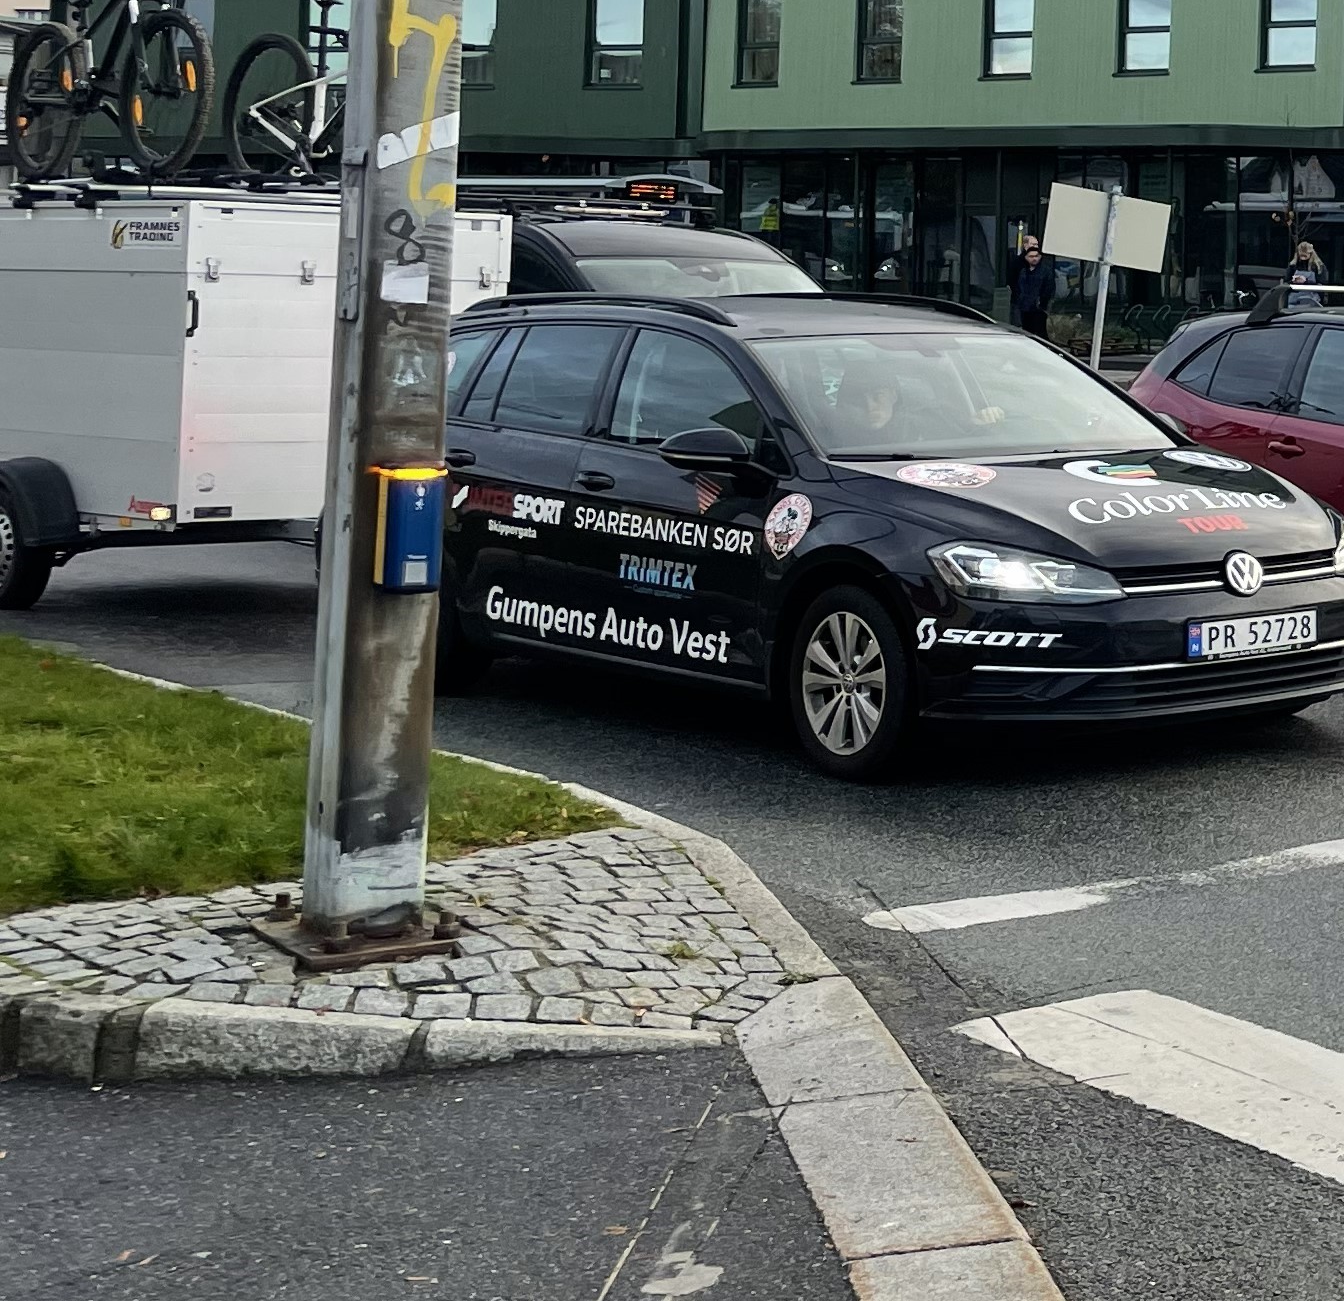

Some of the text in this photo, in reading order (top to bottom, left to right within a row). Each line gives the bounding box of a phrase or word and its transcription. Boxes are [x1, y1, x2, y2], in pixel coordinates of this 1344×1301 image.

[129, 221, 181, 232] FRAMNES
[129, 231, 174, 241] TRADING
[1068, 487, 1287, 525] Color Line
[1176, 513, 1250, 535] TOUR
[574, 506, 755, 556] SPAREBANKEN SØR
[619, 553, 698, 591] TRIMTEX
[486, 585, 731, 664] Gumpens Auto Vest
[938, 628, 1064, 649] SCOTT
[1208, 614, 1311, 651] PR 52728
